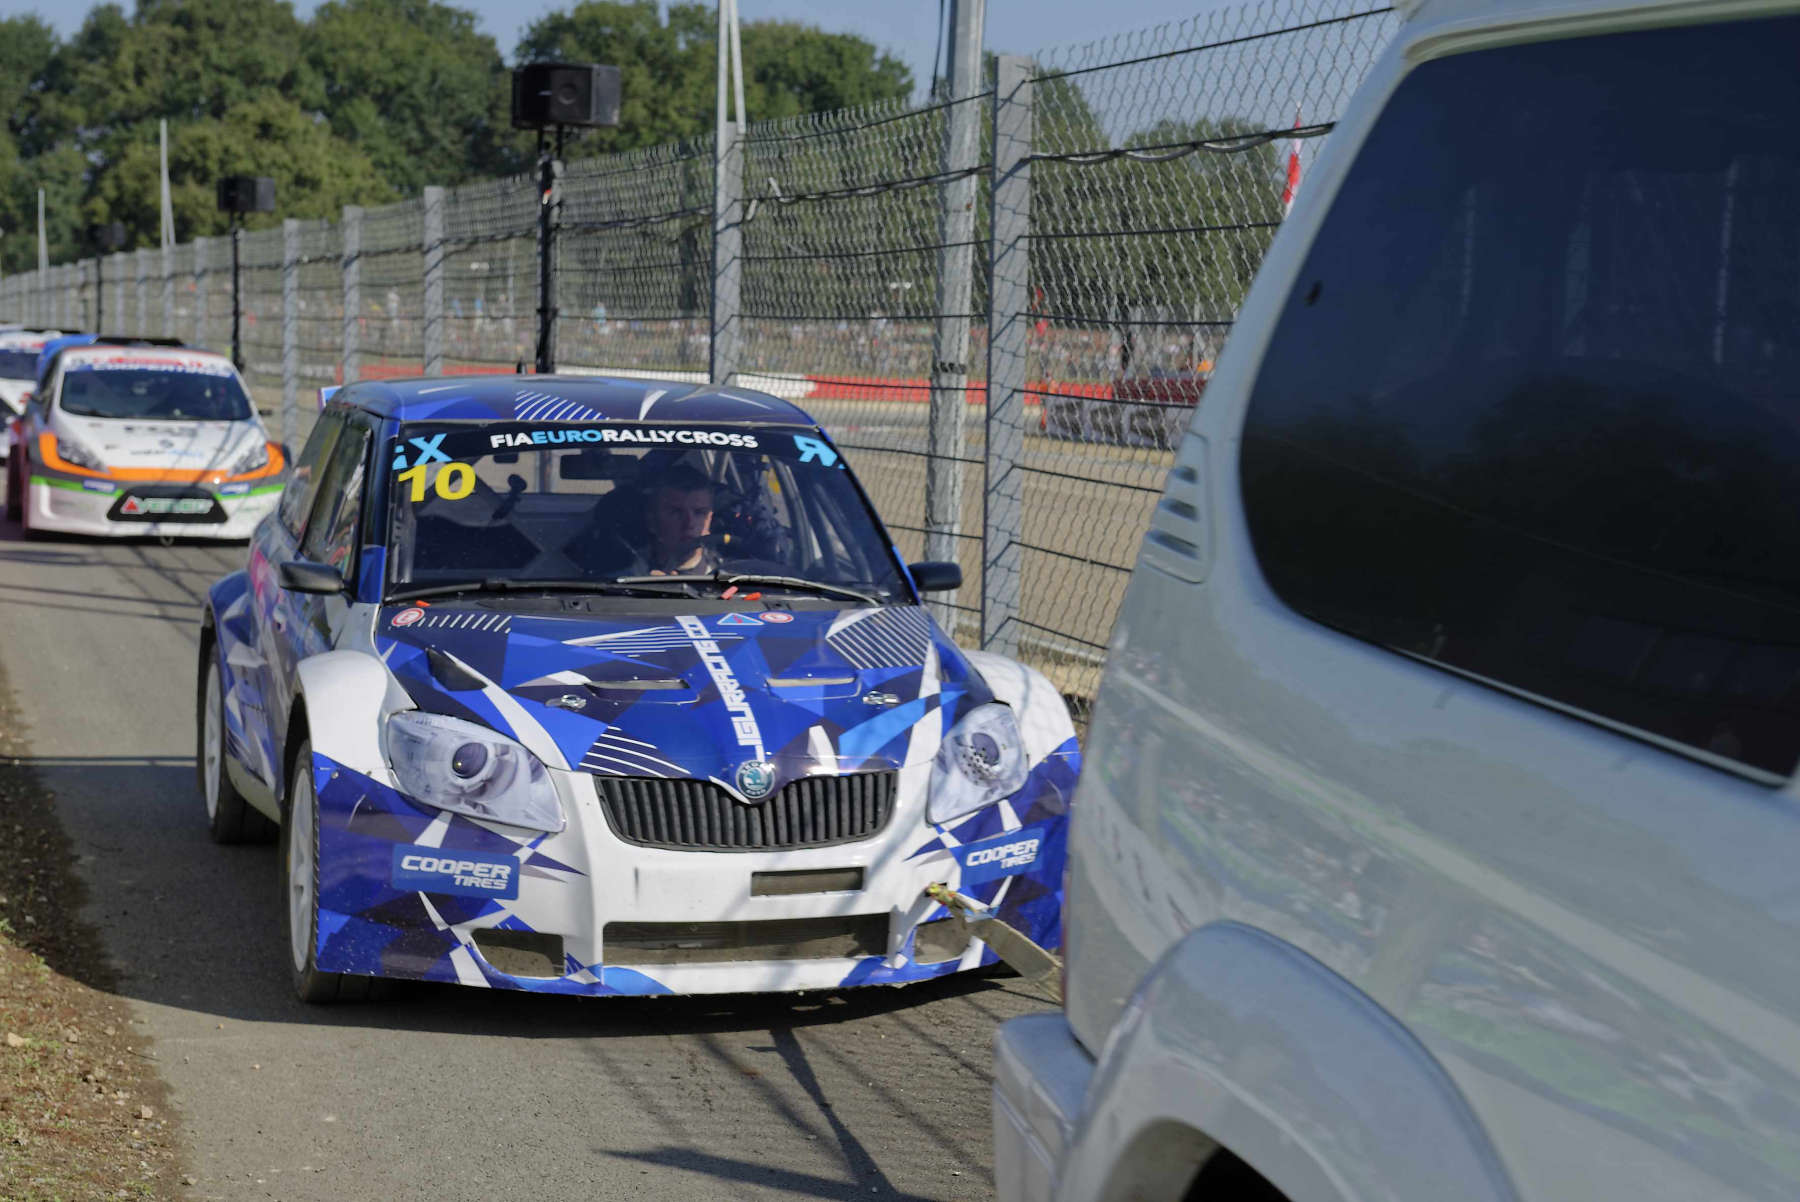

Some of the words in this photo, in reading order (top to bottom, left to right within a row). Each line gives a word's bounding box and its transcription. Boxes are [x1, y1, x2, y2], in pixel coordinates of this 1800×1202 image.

[398, 462, 476, 502] 10
[966, 839, 1040, 867] COOPER
[1001, 853, 1037, 869] TIRES
[401, 855, 512, 879] COOPER
[453, 874, 509, 890] TIRES
